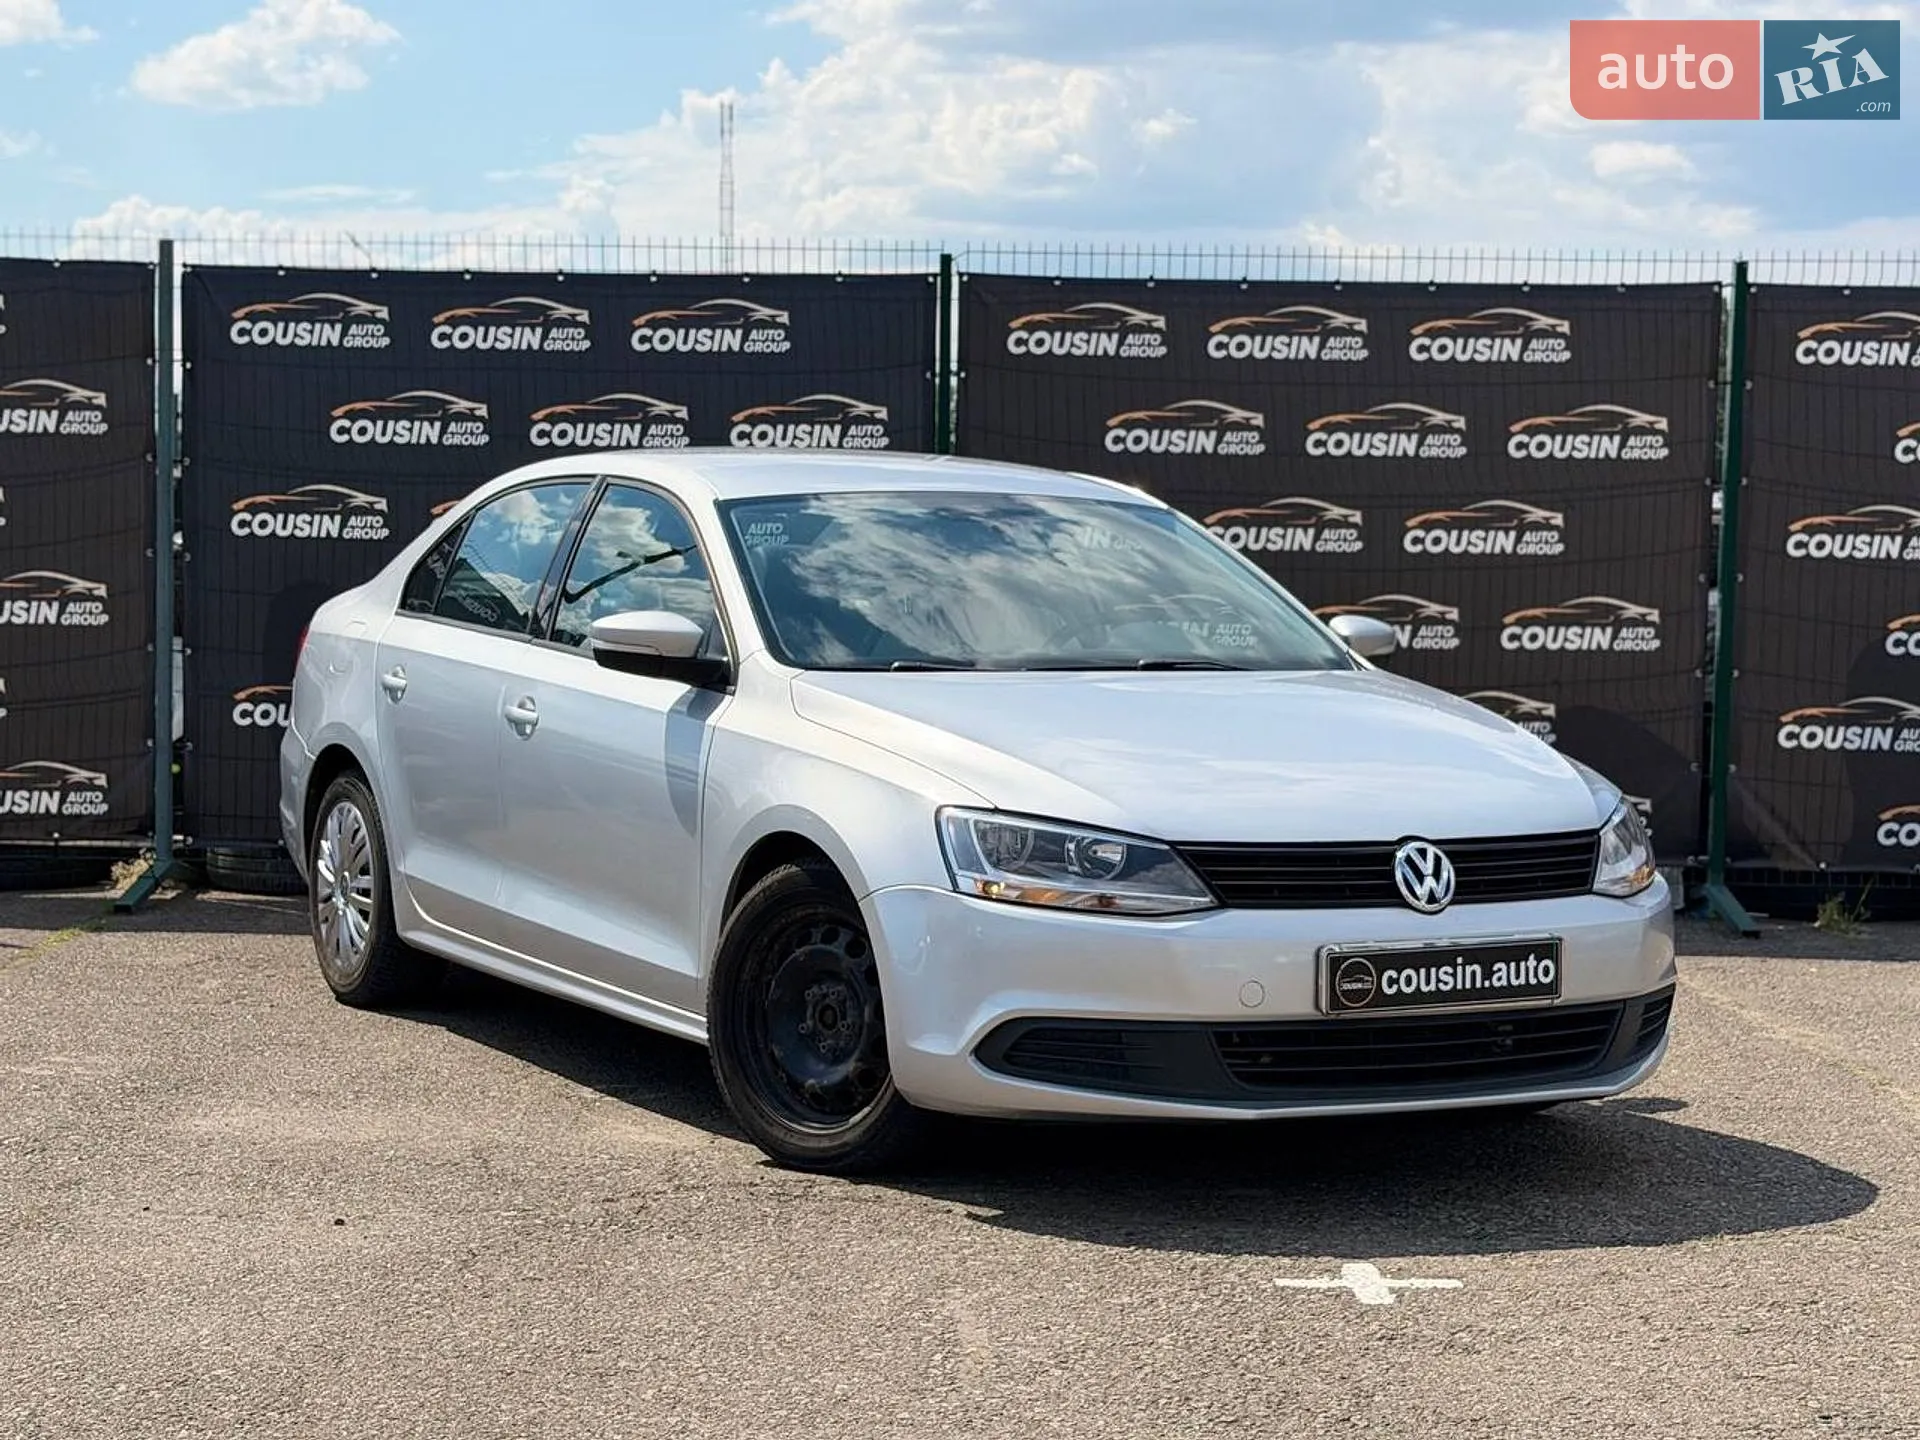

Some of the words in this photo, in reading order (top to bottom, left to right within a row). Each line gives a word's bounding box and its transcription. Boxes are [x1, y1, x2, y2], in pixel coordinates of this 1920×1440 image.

[230, 319, 342, 347] COUSIN
[348, 324, 384, 336] AUTO
[548, 328, 585, 340] AUTO
[748, 329, 784, 341] AUTO
[342, 336, 390, 348] GROUP
[431, 324, 542, 350] COUSIN
[630, 327, 742, 352] COUSIN
[1006, 329, 1119, 356] COUSIN
[1124, 334, 1161, 346] AUTO
[1326, 337, 1362, 349] AUTO
[544, 340, 591, 351] GROUP
[744, 341, 790, 352] GROUP
[1207, 333, 1320, 360] COUSIN
[1408, 336, 1522, 362] COUSIN
[1528, 339, 1565, 351] AUTO
[1120, 346, 1167, 357] GROUP
[1320, 349, 1368, 360] GROUP
[1522, 351, 1571, 362] GROUP
[1795, 339, 1910, 366] COUSIN
[65, 411, 102, 423] AUTO
[60, 423, 108, 434] GROUP
[330, 418, 442, 445] COUSIN
[447, 422, 483, 434] AUTO
[530, 421, 641, 446] COUSIN
[647, 424, 683, 436] AUTO
[847, 425, 883, 437] AUTO
[442, 434, 489, 445] GROUP
[729, 423, 841, 448] COUSIN
[1105, 428, 1217, 454] COUSIN
[1222, 432, 1259, 444] AUTO
[1424, 434, 1461, 446] AUTO
[642, 436, 689, 448] GROUP
[842, 437, 889, 448] GROUP
[1305, 431, 1418, 457] COUSIN
[1507, 433, 1620, 460] COUSIN
[1626, 436, 1663, 448] AUTO
[1216, 444, 1265, 455] GROUP
[1418, 446, 1467, 458] GROUP
[1620, 448, 1669, 459] GROUP
[231, 511, 341, 537] COUSIN
[347, 516, 383, 528] AUTO
[342, 528, 389, 539] GROUP
[1320, 529, 1357, 541] AUTO
[1521, 531, 1558, 543] AUTO
[1314, 541, 1363, 552] GROUP
[1403, 528, 1516, 555] COUSIN
[1786, 533, 1902, 560] COUSIN
[1516, 543, 1564, 555] GROUP
[66, 602, 103, 614] AUTO
[60, 614, 109, 625] GROUP
[1416, 626, 1453, 638] AUTO
[1501, 625, 1612, 651] COUSIN
[1618, 627, 1654, 639] AUTO
[1412, 638, 1459, 649] GROUP
[1612, 639, 1660, 651] GROUP
[1777, 724, 1893, 751] COUSIN
[66, 792, 102, 804] AUTO
[62, 804, 108, 814] GROUP
[1381, 955, 1555, 996] cousin.auto
